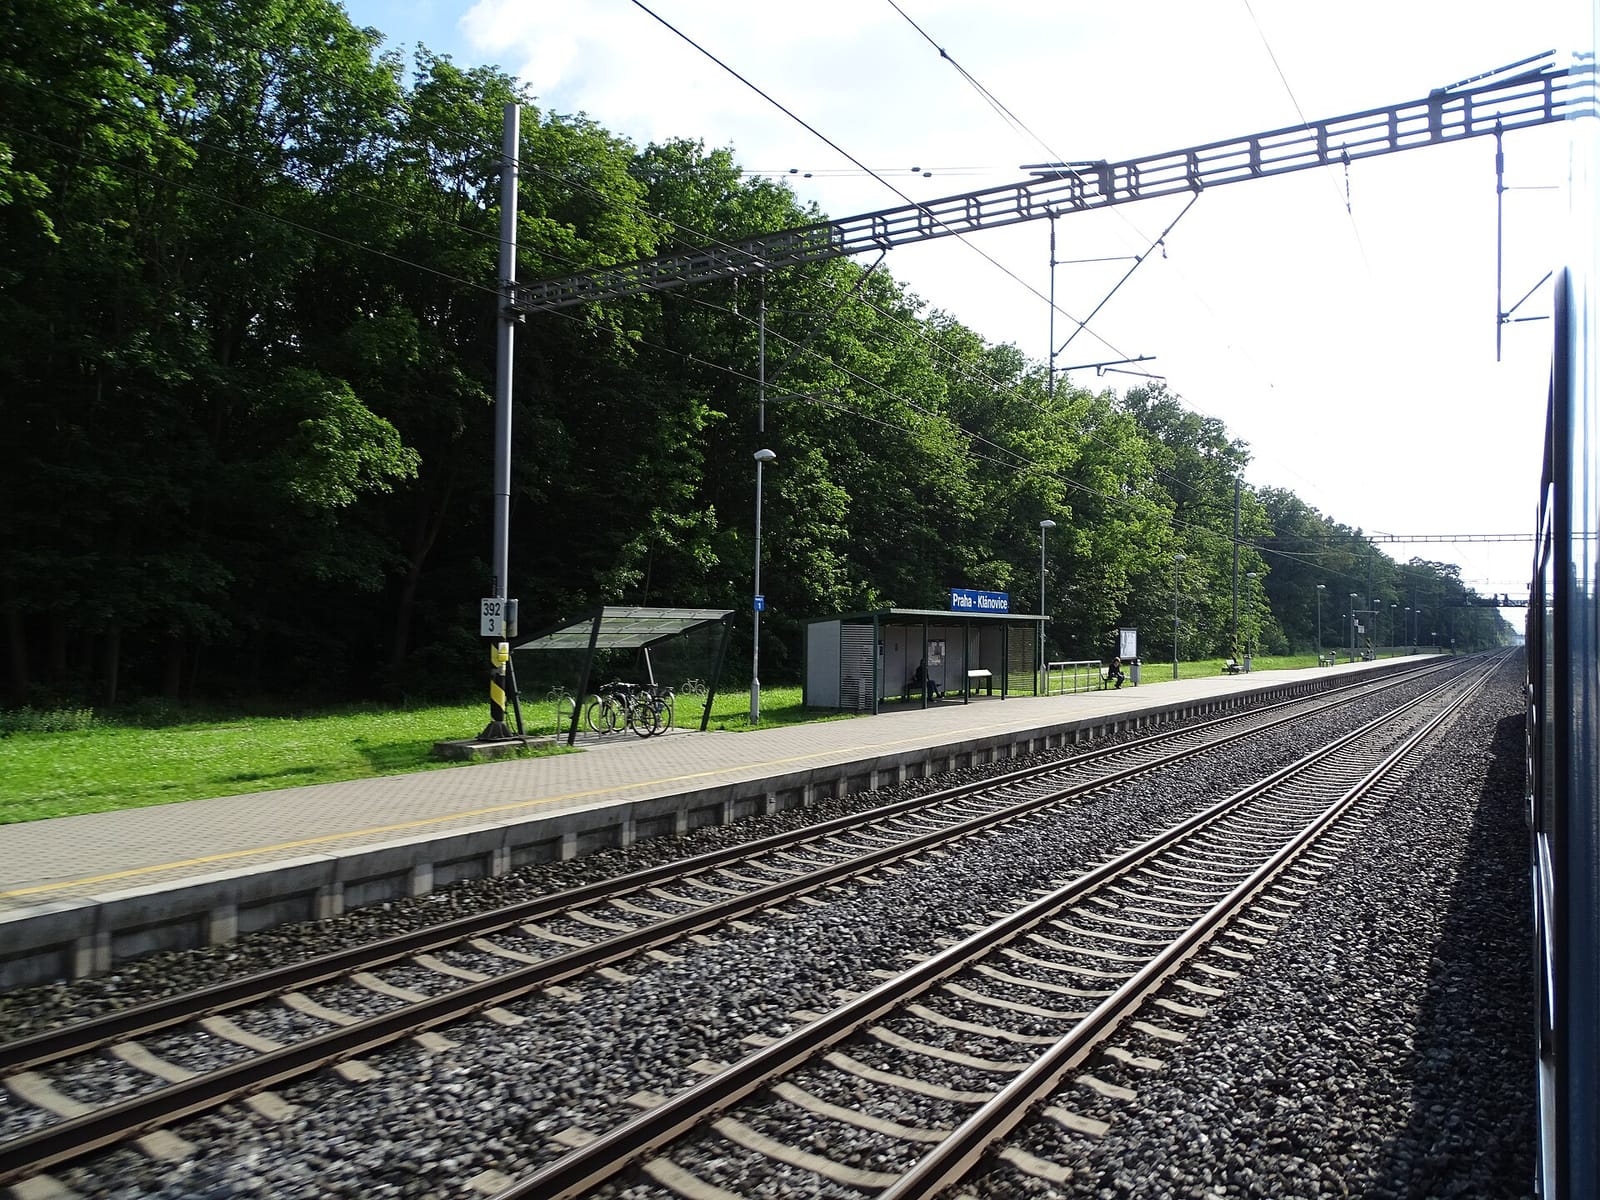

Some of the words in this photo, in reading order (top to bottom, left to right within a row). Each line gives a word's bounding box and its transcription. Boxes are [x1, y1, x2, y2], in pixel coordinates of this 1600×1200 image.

[952, 593, 972, 608] Praha
[977, 595, 1008, 610] Klánovice
[483, 602, 501, 617] 392
[488, 618, 495, 632] 3
